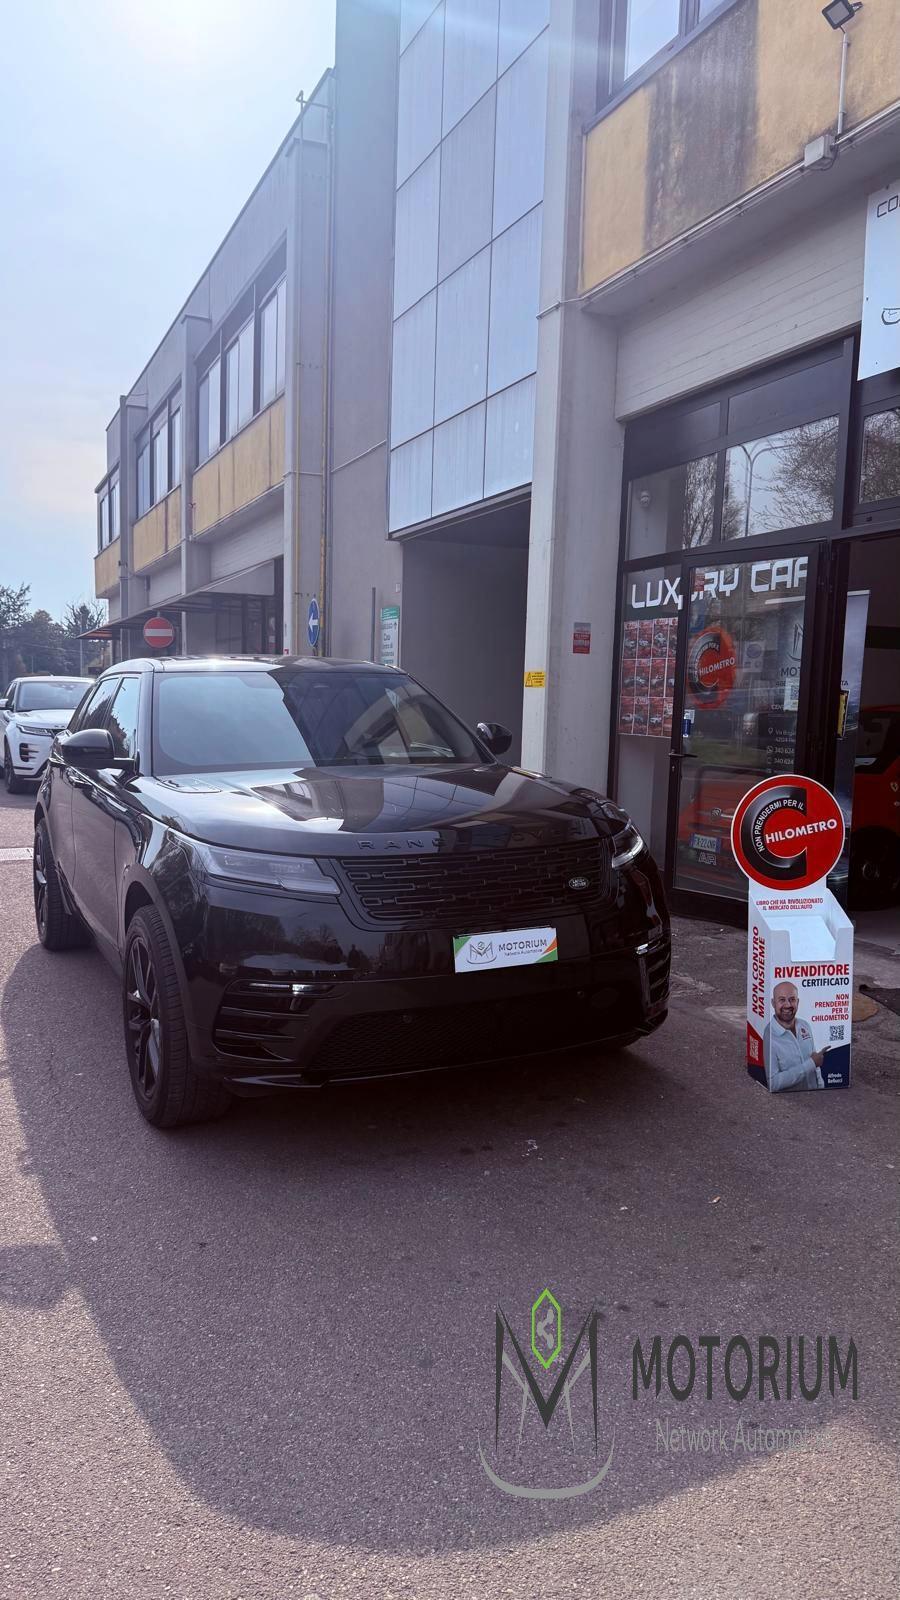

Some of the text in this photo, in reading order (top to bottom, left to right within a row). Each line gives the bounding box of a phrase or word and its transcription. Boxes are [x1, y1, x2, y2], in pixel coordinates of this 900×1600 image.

[877, 195, 900, 218] CO
[780, 666, 800, 677] MO
[754, 799, 805, 852] NON PRENDERMI PER IL
[788, 897, 824, 905] RIVOLUZIONATO
[498, 939, 547, 952] MOTORIUM
[774, 963, 850, 978] RIVENDITORE
[801, 977, 850, 988] CERTIFICATO
[758, 996, 765, 1018] MA
[814, 1000, 850, 1008] PRENDERMI
[811, 1013, 850, 1022] CHILOMETRO
